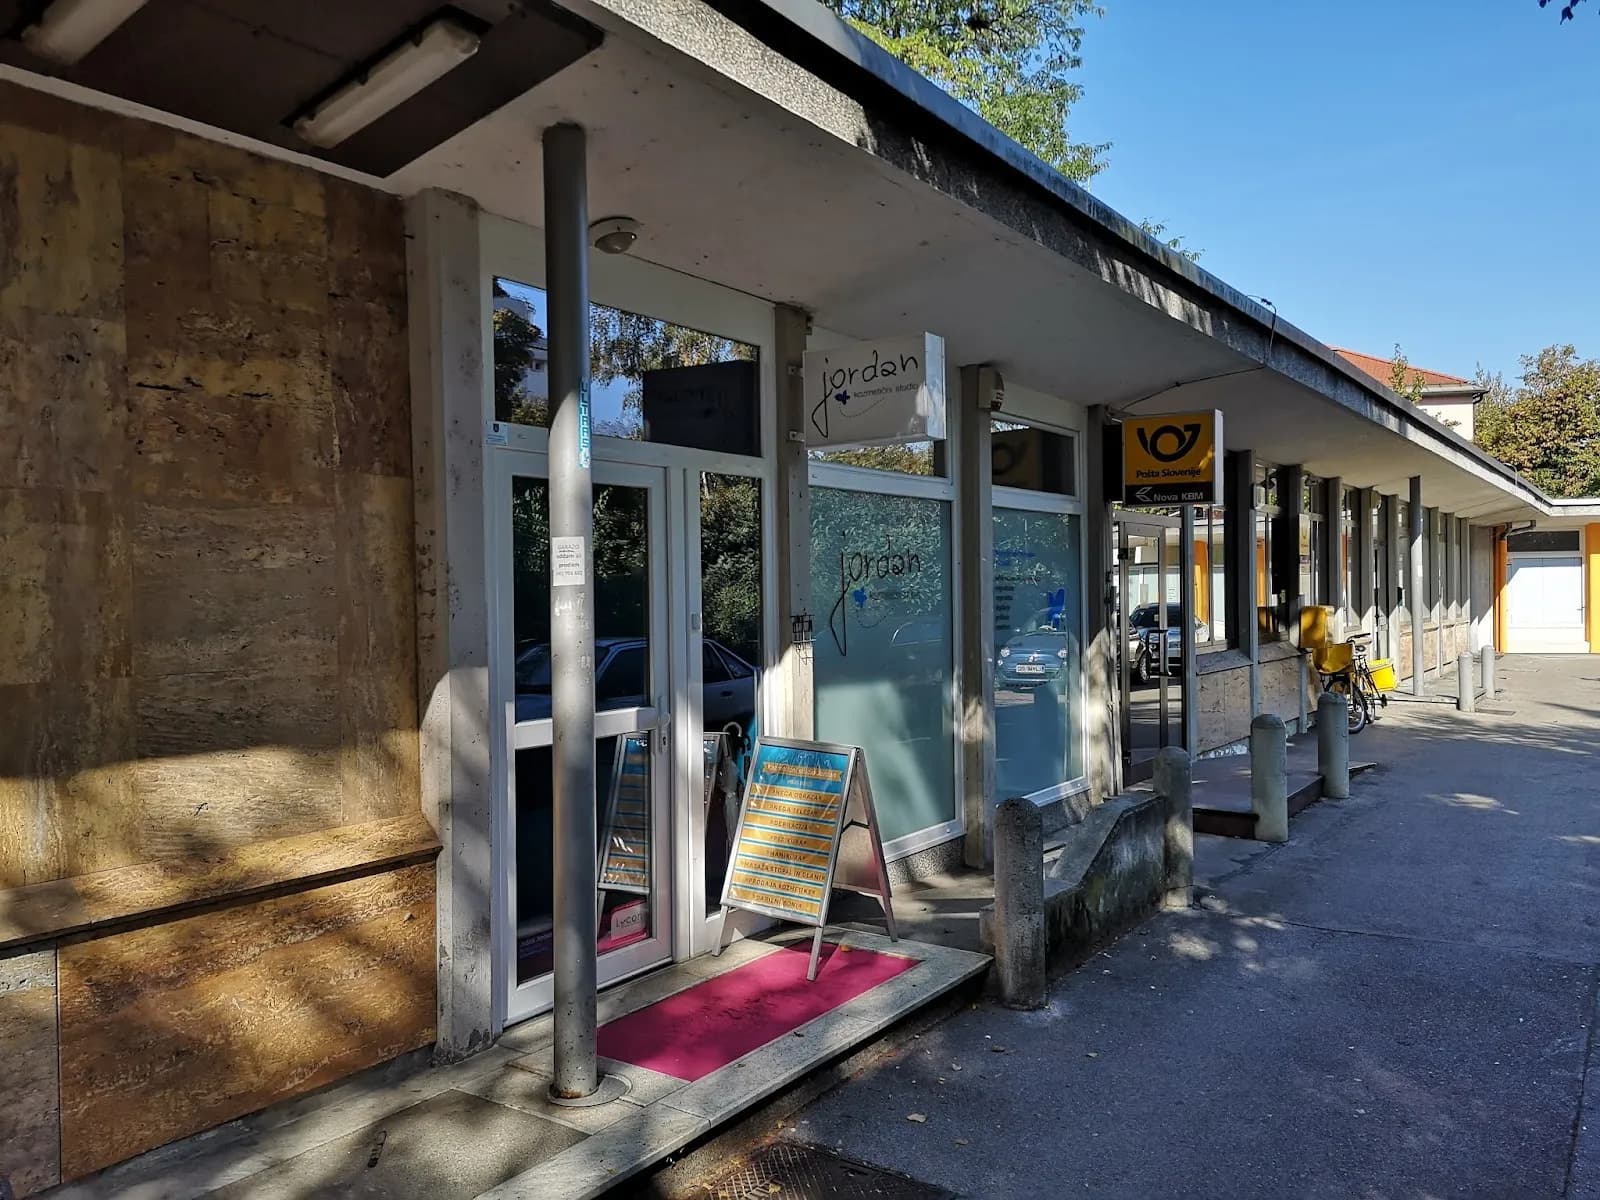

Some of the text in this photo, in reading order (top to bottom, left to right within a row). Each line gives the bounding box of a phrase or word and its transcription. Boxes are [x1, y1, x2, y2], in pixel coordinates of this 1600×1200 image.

[811, 349, 919, 438] jordan
[1153, 492, 1204, 501] Nova KBM
[1161, 467, 1201, 478] Slovenije
[830, 531, 921, 657] jordan
